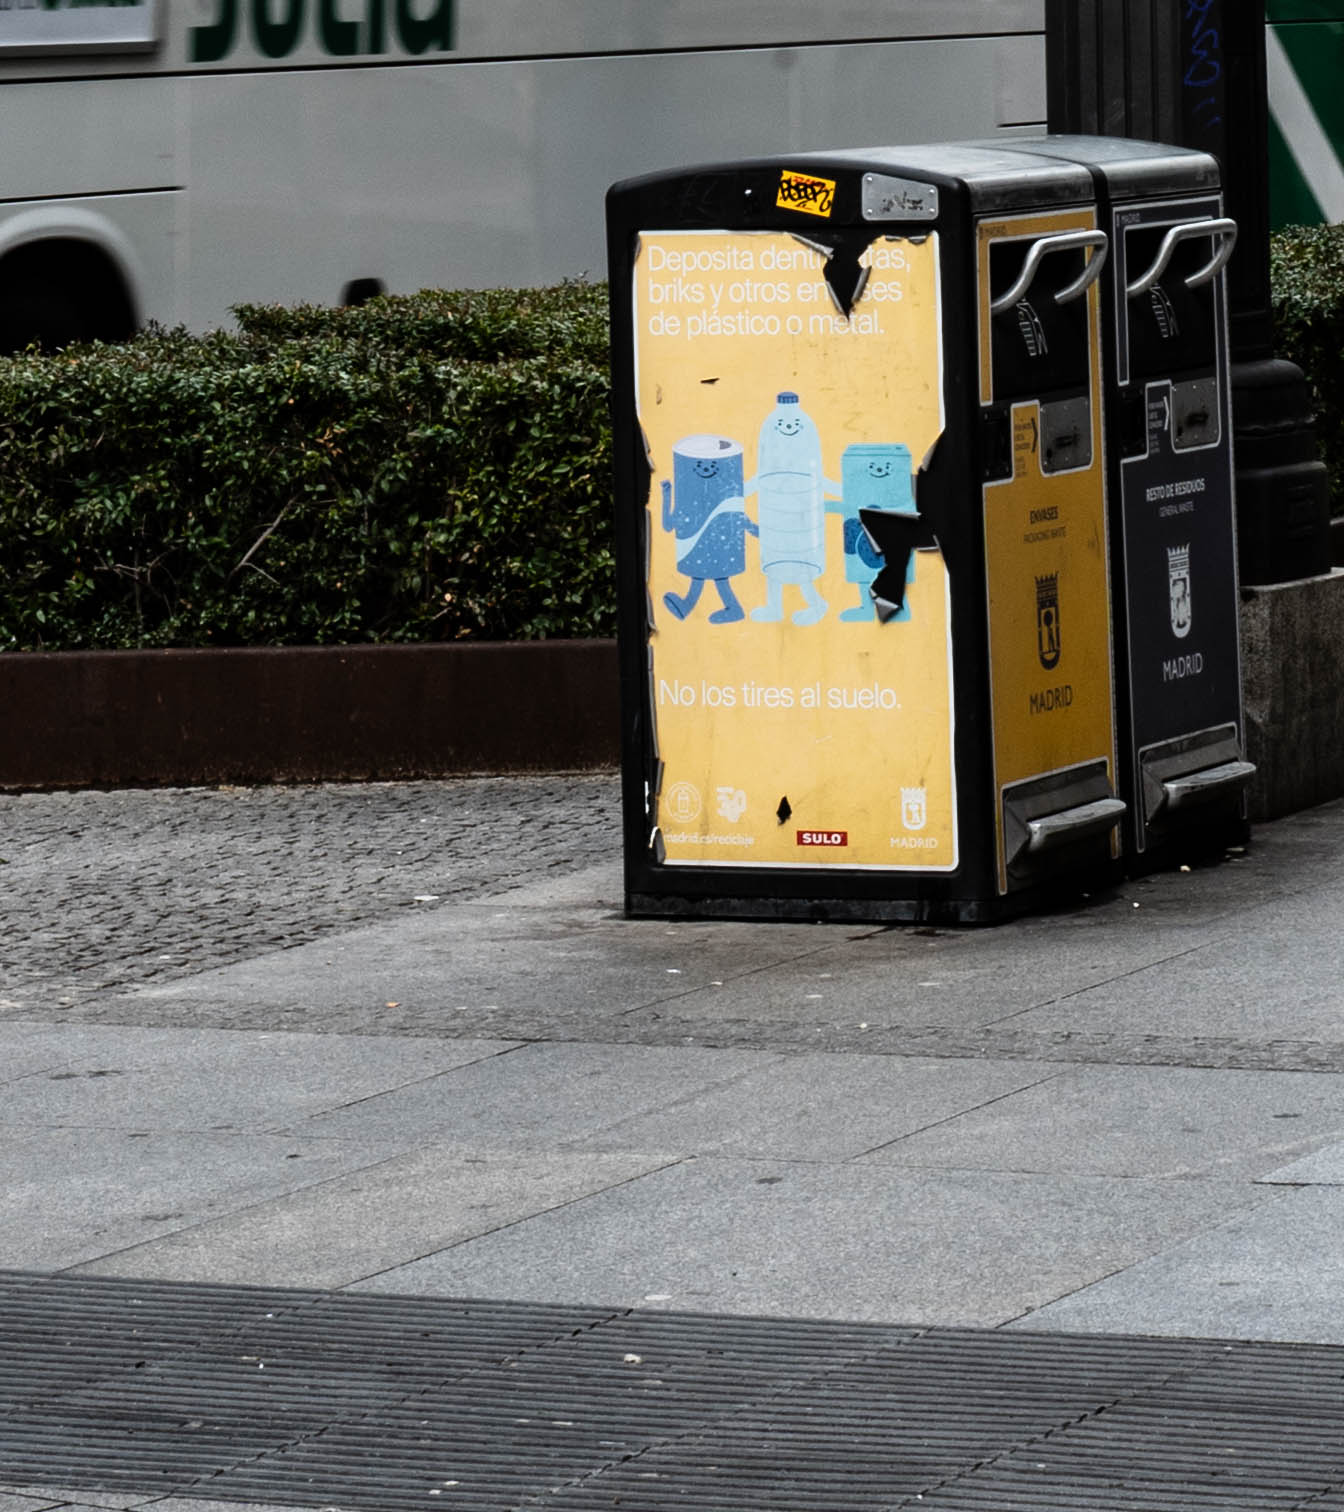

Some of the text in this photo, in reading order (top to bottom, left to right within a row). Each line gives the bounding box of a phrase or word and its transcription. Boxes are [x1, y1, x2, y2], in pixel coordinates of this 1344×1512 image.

[647, 244, 911, 276] Deposita dent tas,
[647, 278, 903, 308] briks y otros enses
[648, 310, 885, 340] de plástico o metal.
[1146, 478, 1206, 502] RESTO DE RESIDUOS
[1029, 506, 1059, 525] ENVASES
[1163, 652, 1204, 683] MADRID
[659, 679, 903, 710] No los tires al suelo.
[1029, 684, 1074, 715] MADRID
[802, 832, 842, 845] SULO
[889, 837, 939, 849] MADRID
